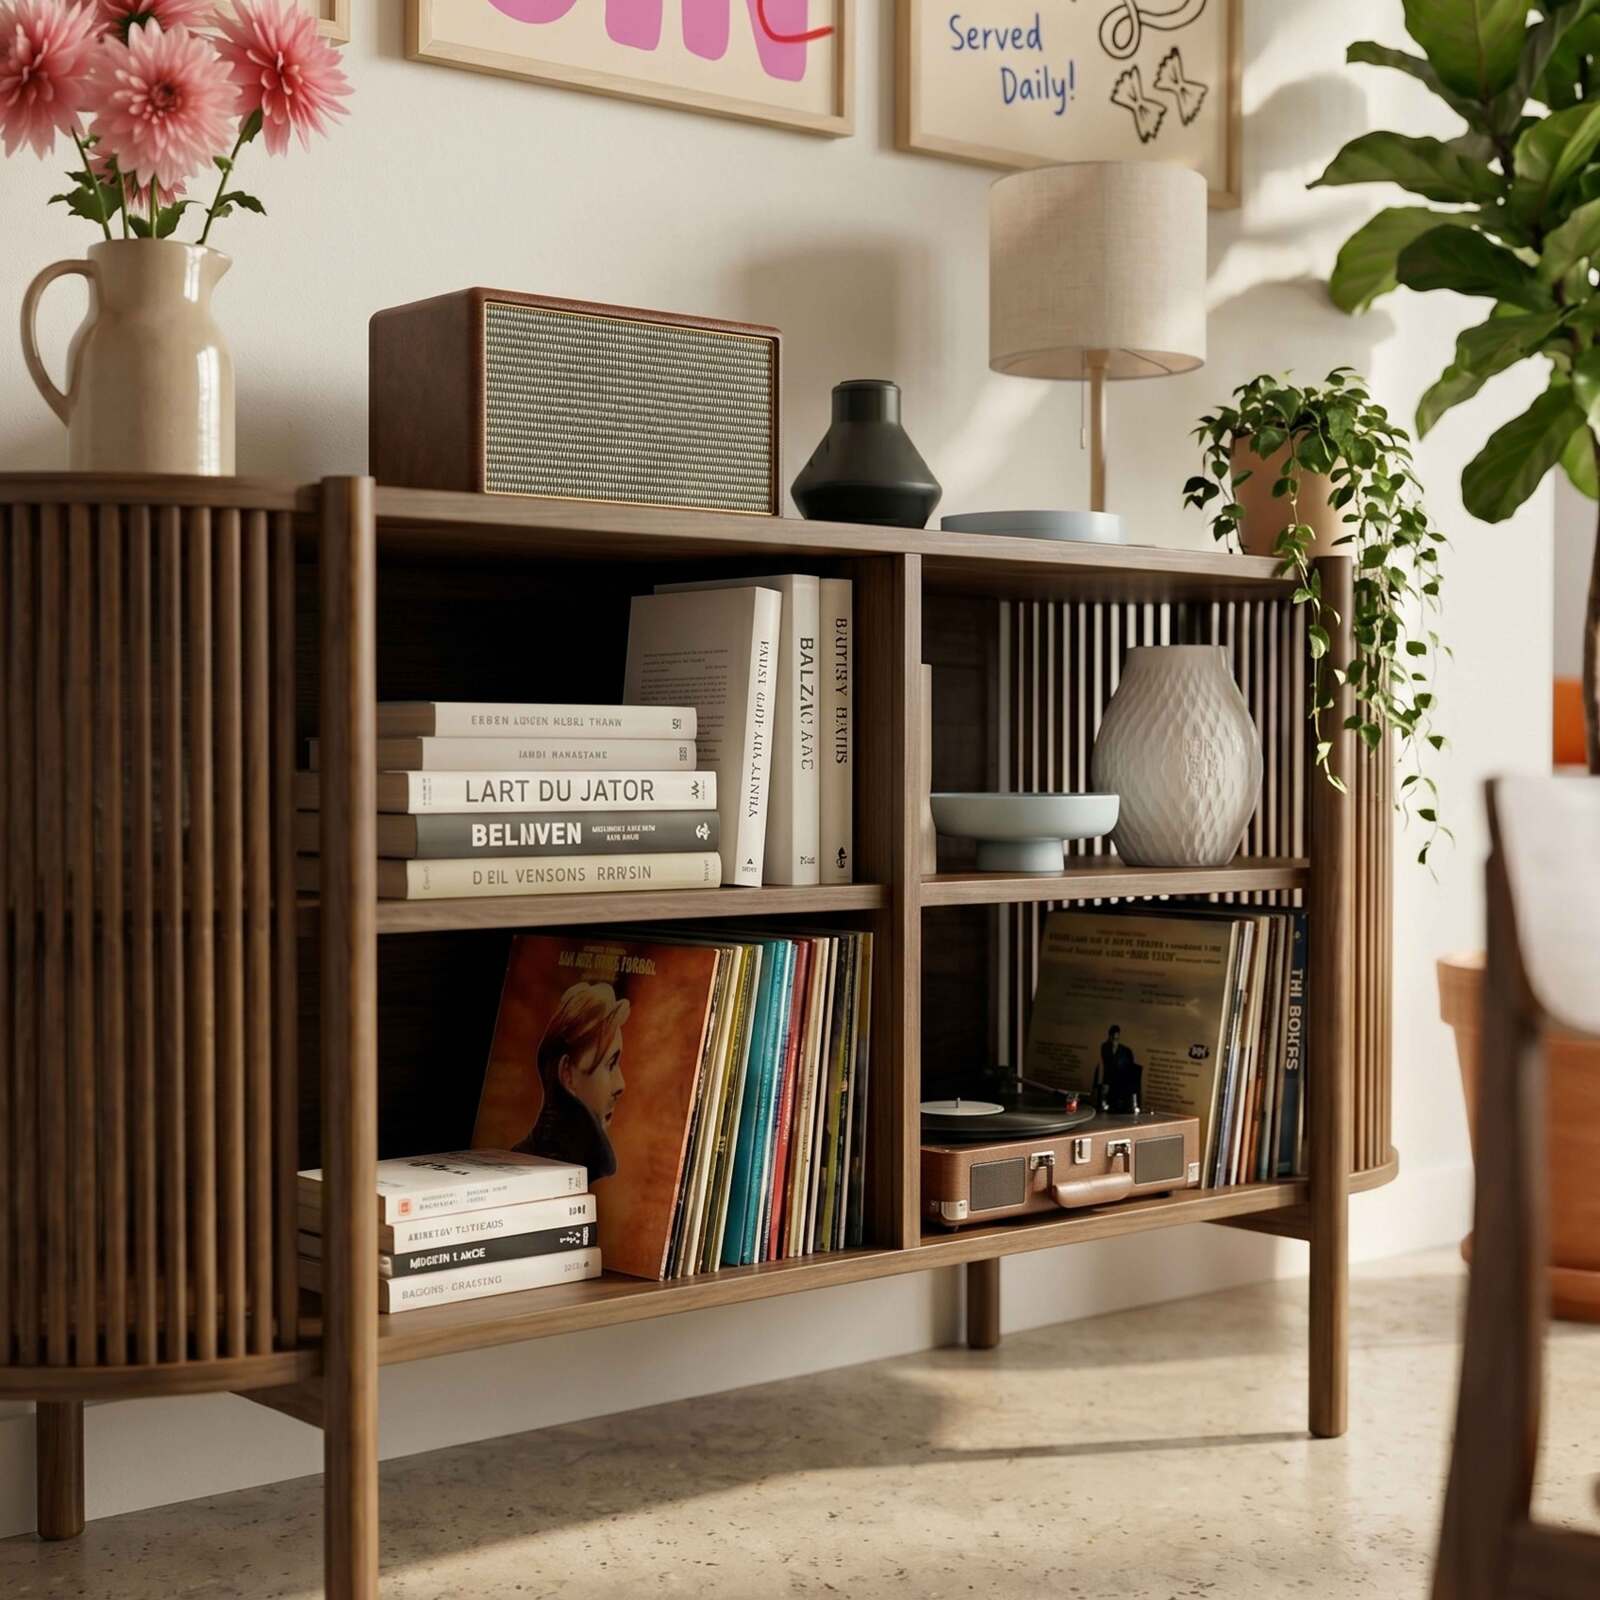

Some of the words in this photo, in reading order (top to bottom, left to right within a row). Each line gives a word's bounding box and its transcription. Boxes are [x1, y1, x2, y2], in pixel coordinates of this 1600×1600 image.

[949, 12, 1042, 51] Served
[1001, 60, 1075, 116] Daily!
[465, 779, 530, 803] LART
[539, 779, 571, 802] DU
[580, 779, 655, 802] JATOR
[515, 867, 586, 884] VENSONS
